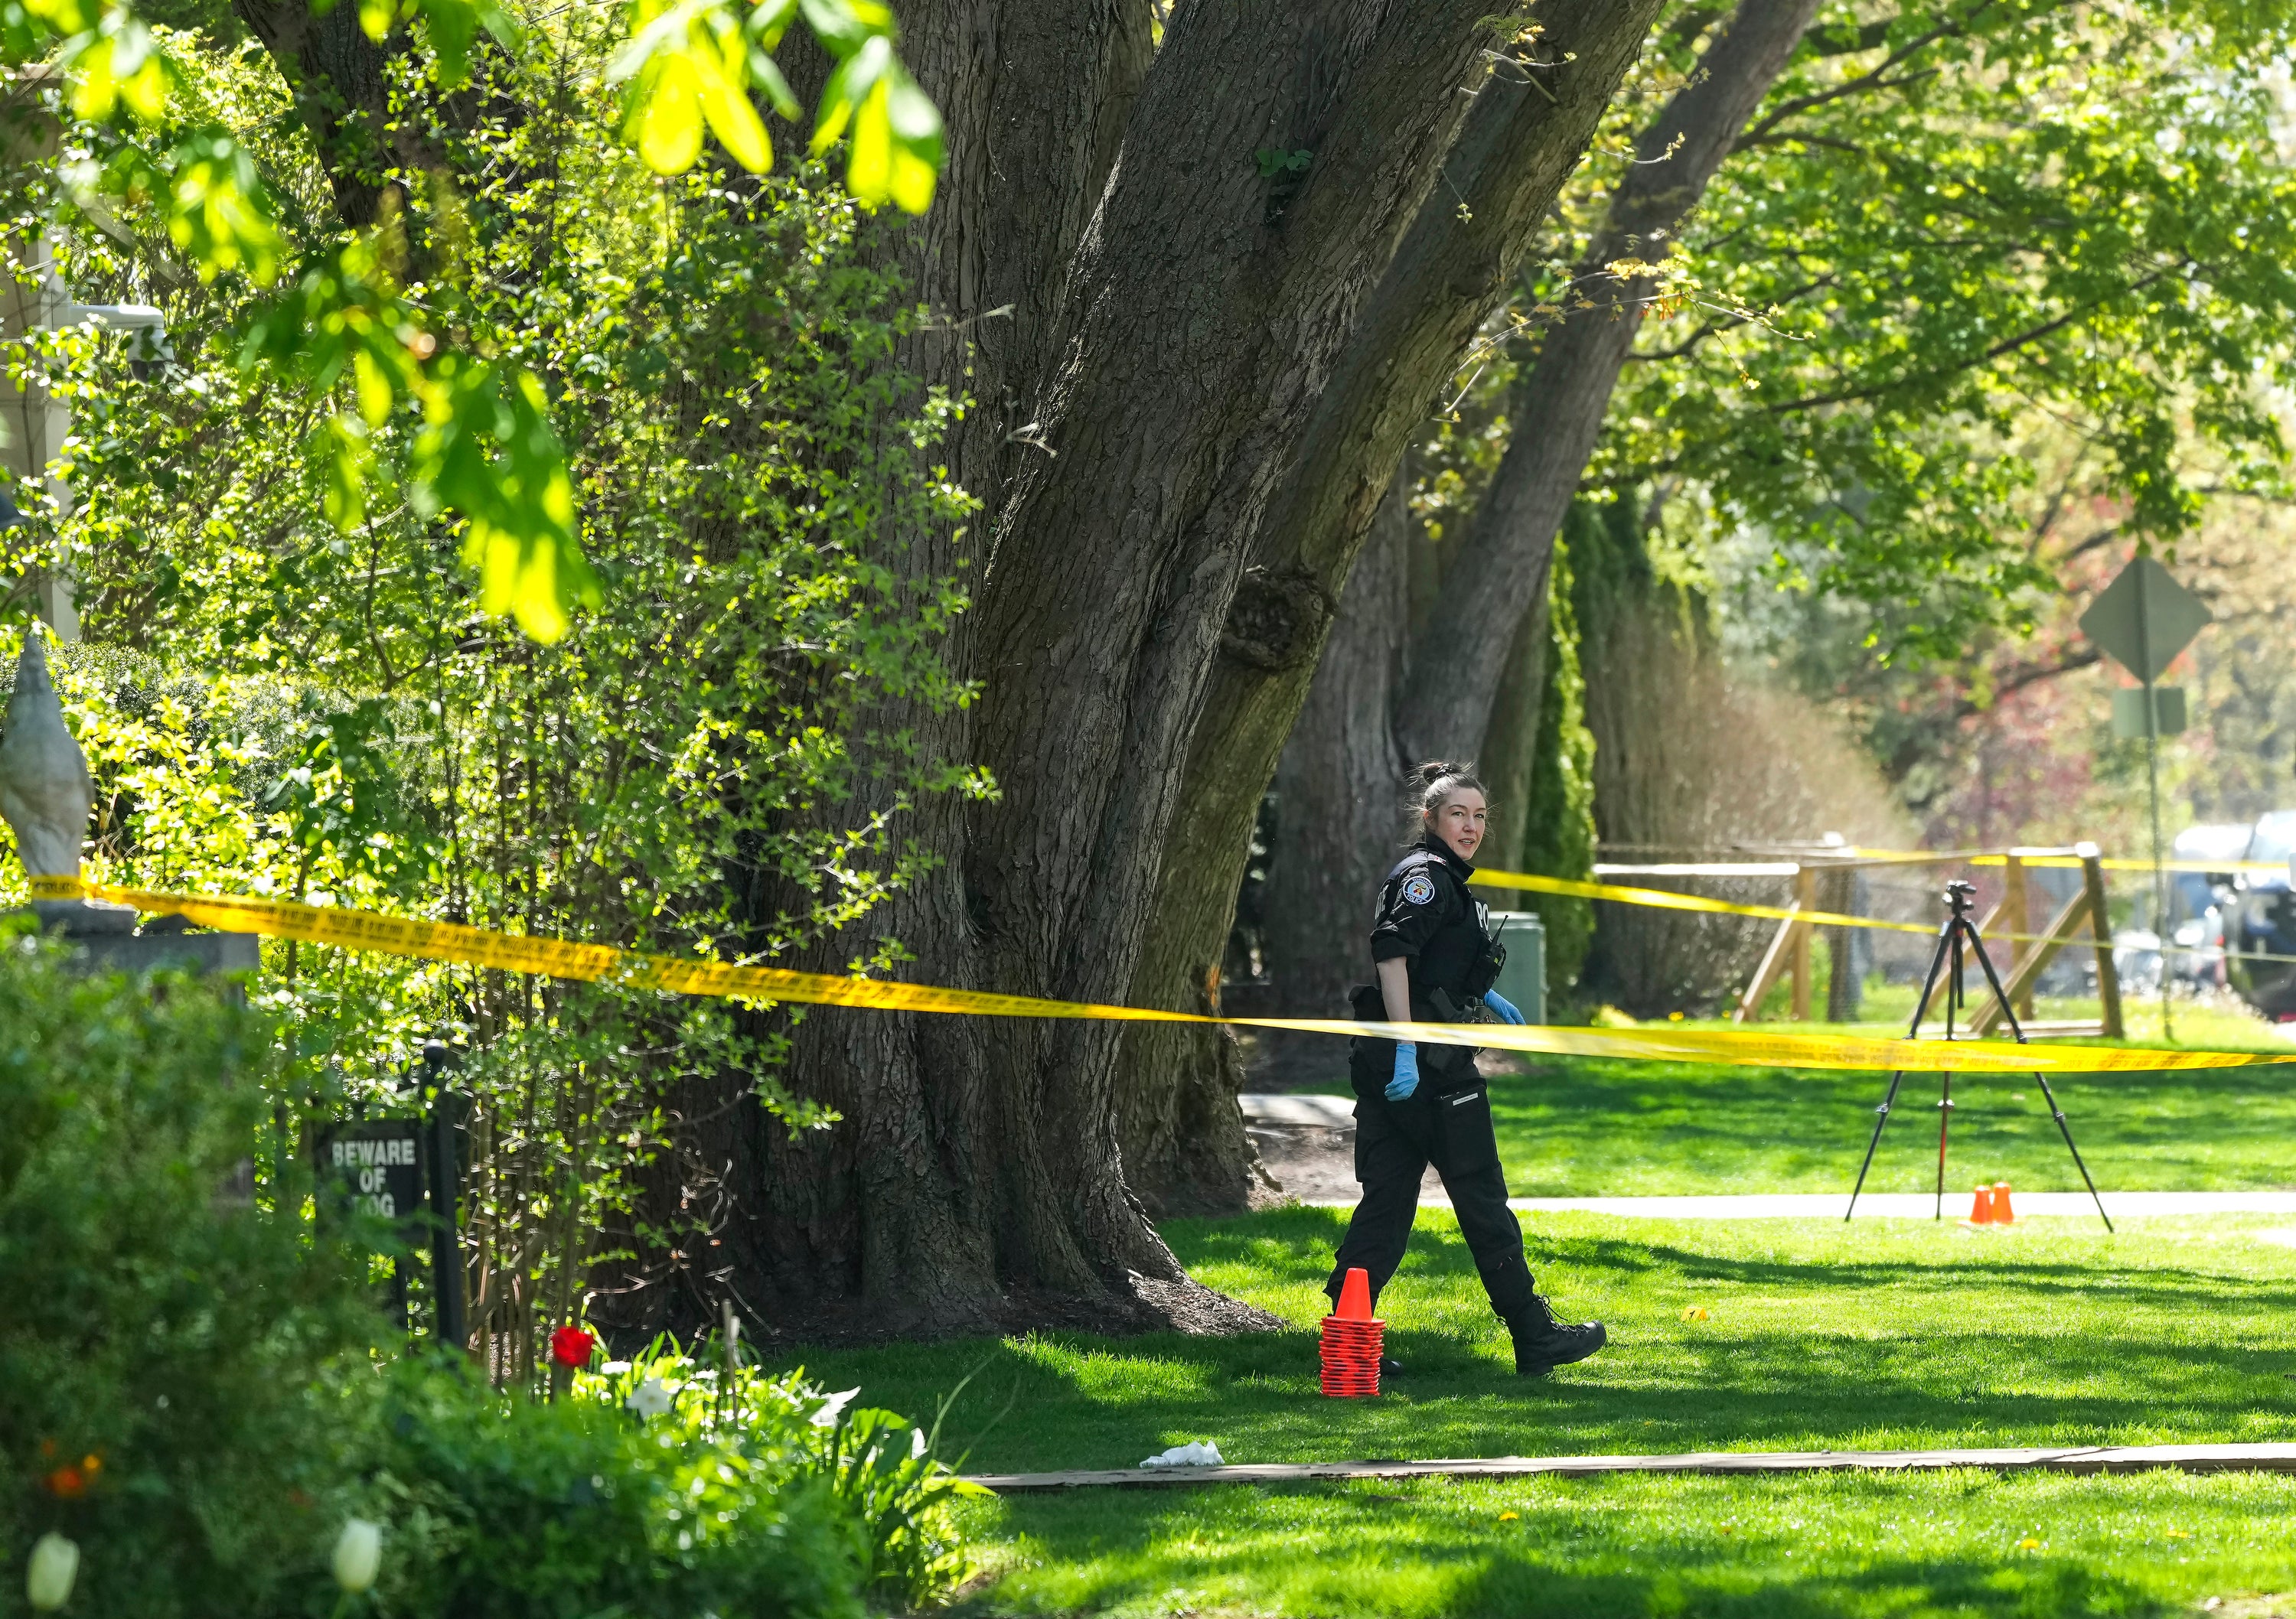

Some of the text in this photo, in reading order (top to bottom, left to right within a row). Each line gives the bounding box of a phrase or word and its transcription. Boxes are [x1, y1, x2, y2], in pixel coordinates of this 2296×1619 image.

[1412, 878, 1433, 890] TORONTO
[1407, 894, 1423, 904] POLICE
[331, 1139, 416, 1167] BEWARE
[358, 1165, 387, 1194] OF
